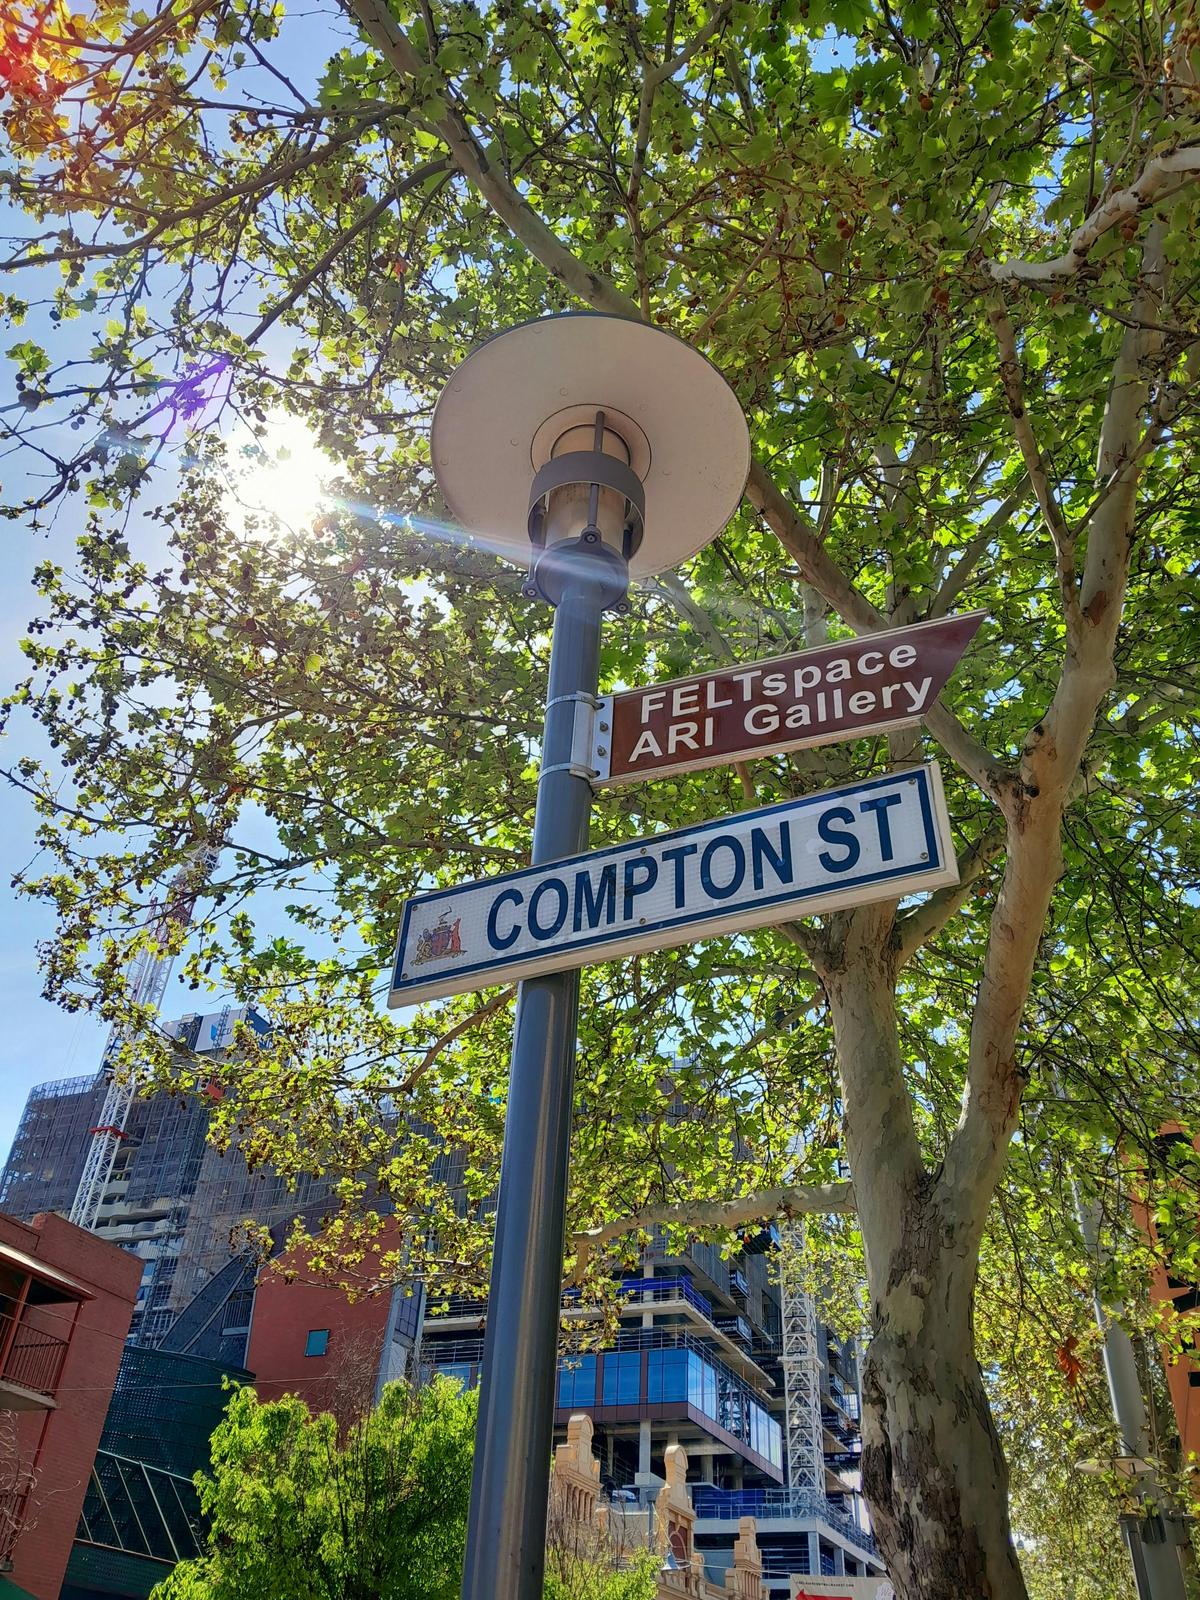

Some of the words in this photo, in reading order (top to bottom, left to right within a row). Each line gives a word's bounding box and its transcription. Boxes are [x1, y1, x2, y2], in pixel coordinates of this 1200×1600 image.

[627, 716, 715, 764] ARI
[743, 676, 934, 736] Gallery
[640, 644, 918, 725] FELTspace
[486, 820, 795, 951] COMPTON
[816, 792, 902, 875] ST
